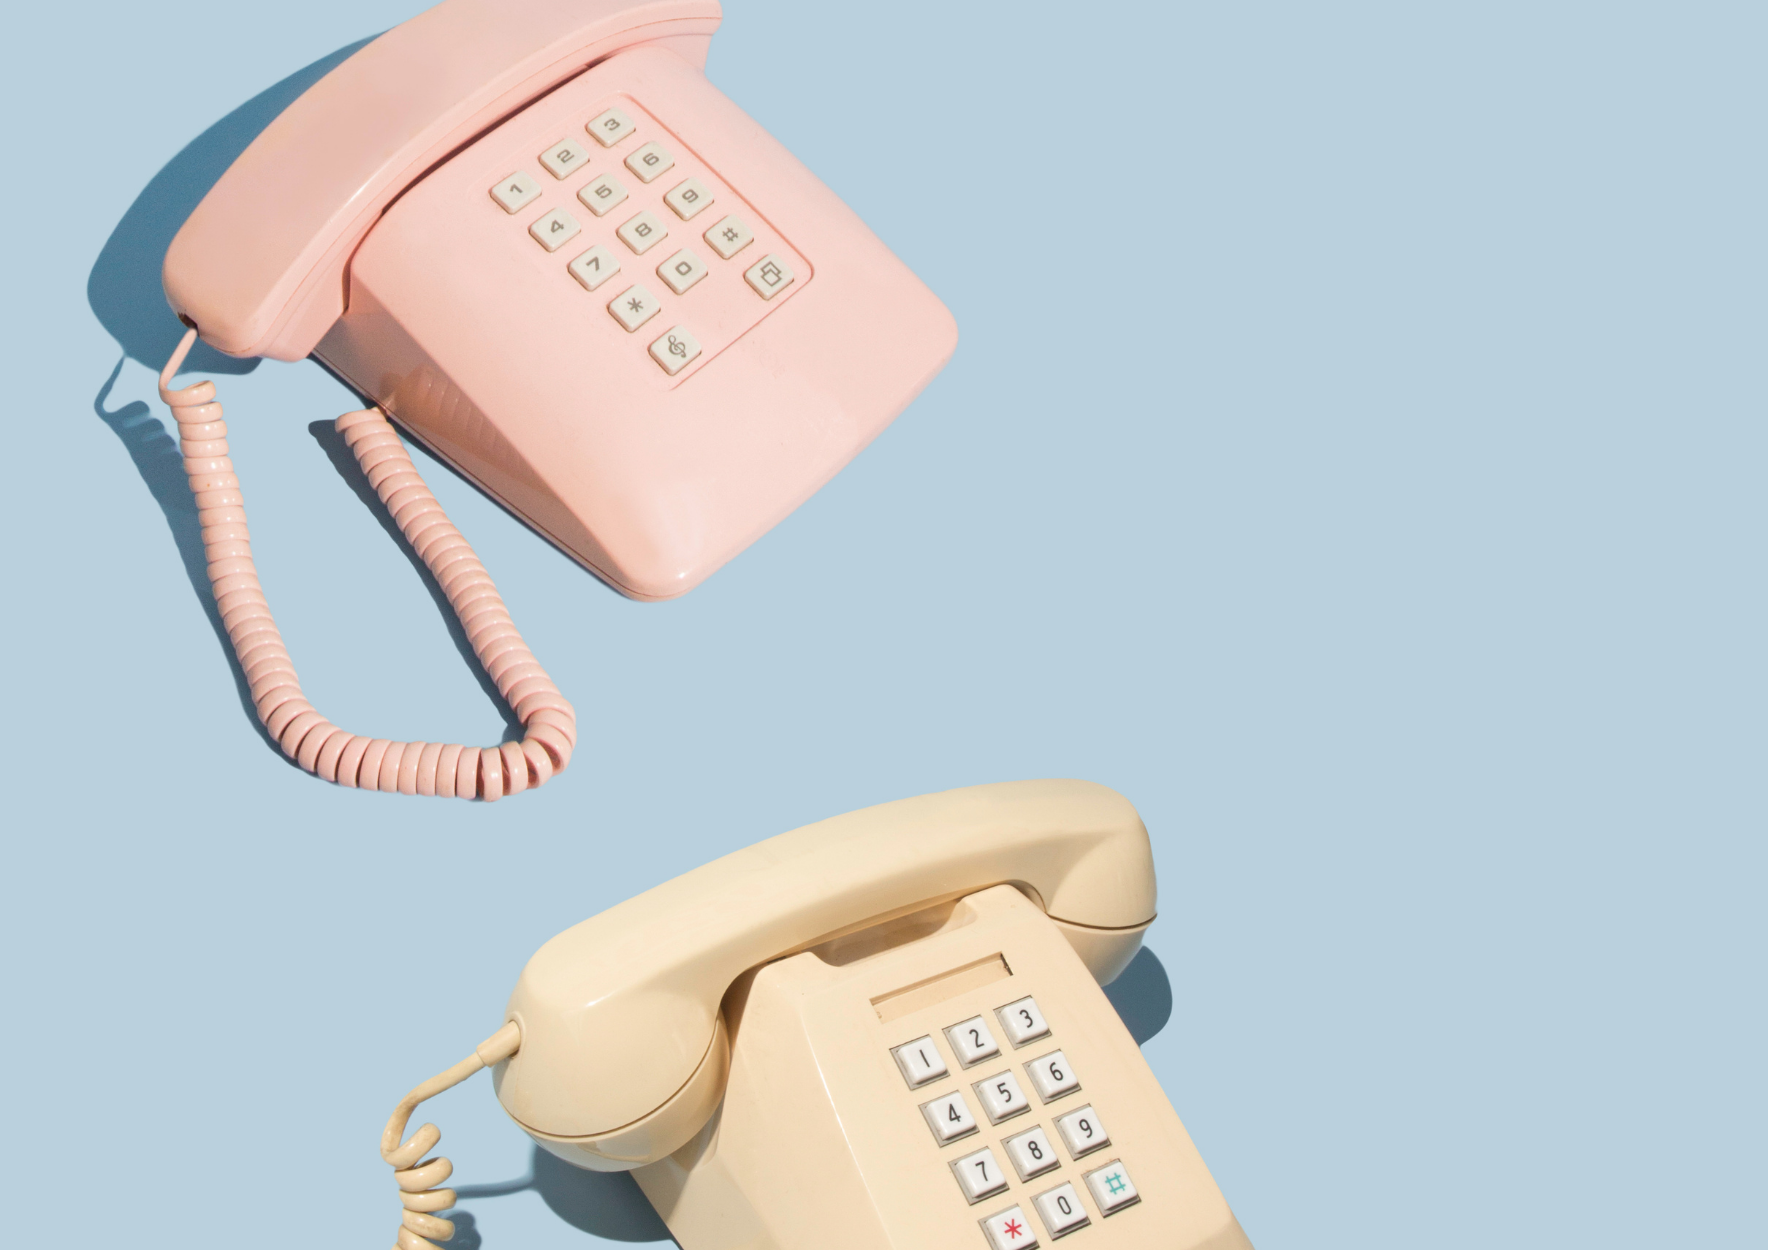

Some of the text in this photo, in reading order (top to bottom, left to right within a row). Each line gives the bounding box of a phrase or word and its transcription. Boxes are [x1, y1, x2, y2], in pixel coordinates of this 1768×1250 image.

[509, 117, 621, 194] 1 2 3
[550, 152, 660, 234] 4 5 6
[585, 188, 699, 272] 7 8 9
[674, 260, 693, 277] 0
[918, 1009, 1034, 1068] 1 2 3
[948, 1061, 1064, 1123] 4 5 6
[974, 1118, 1093, 1182] 7 8 9
[1056, 1195, 1072, 1216] 0
